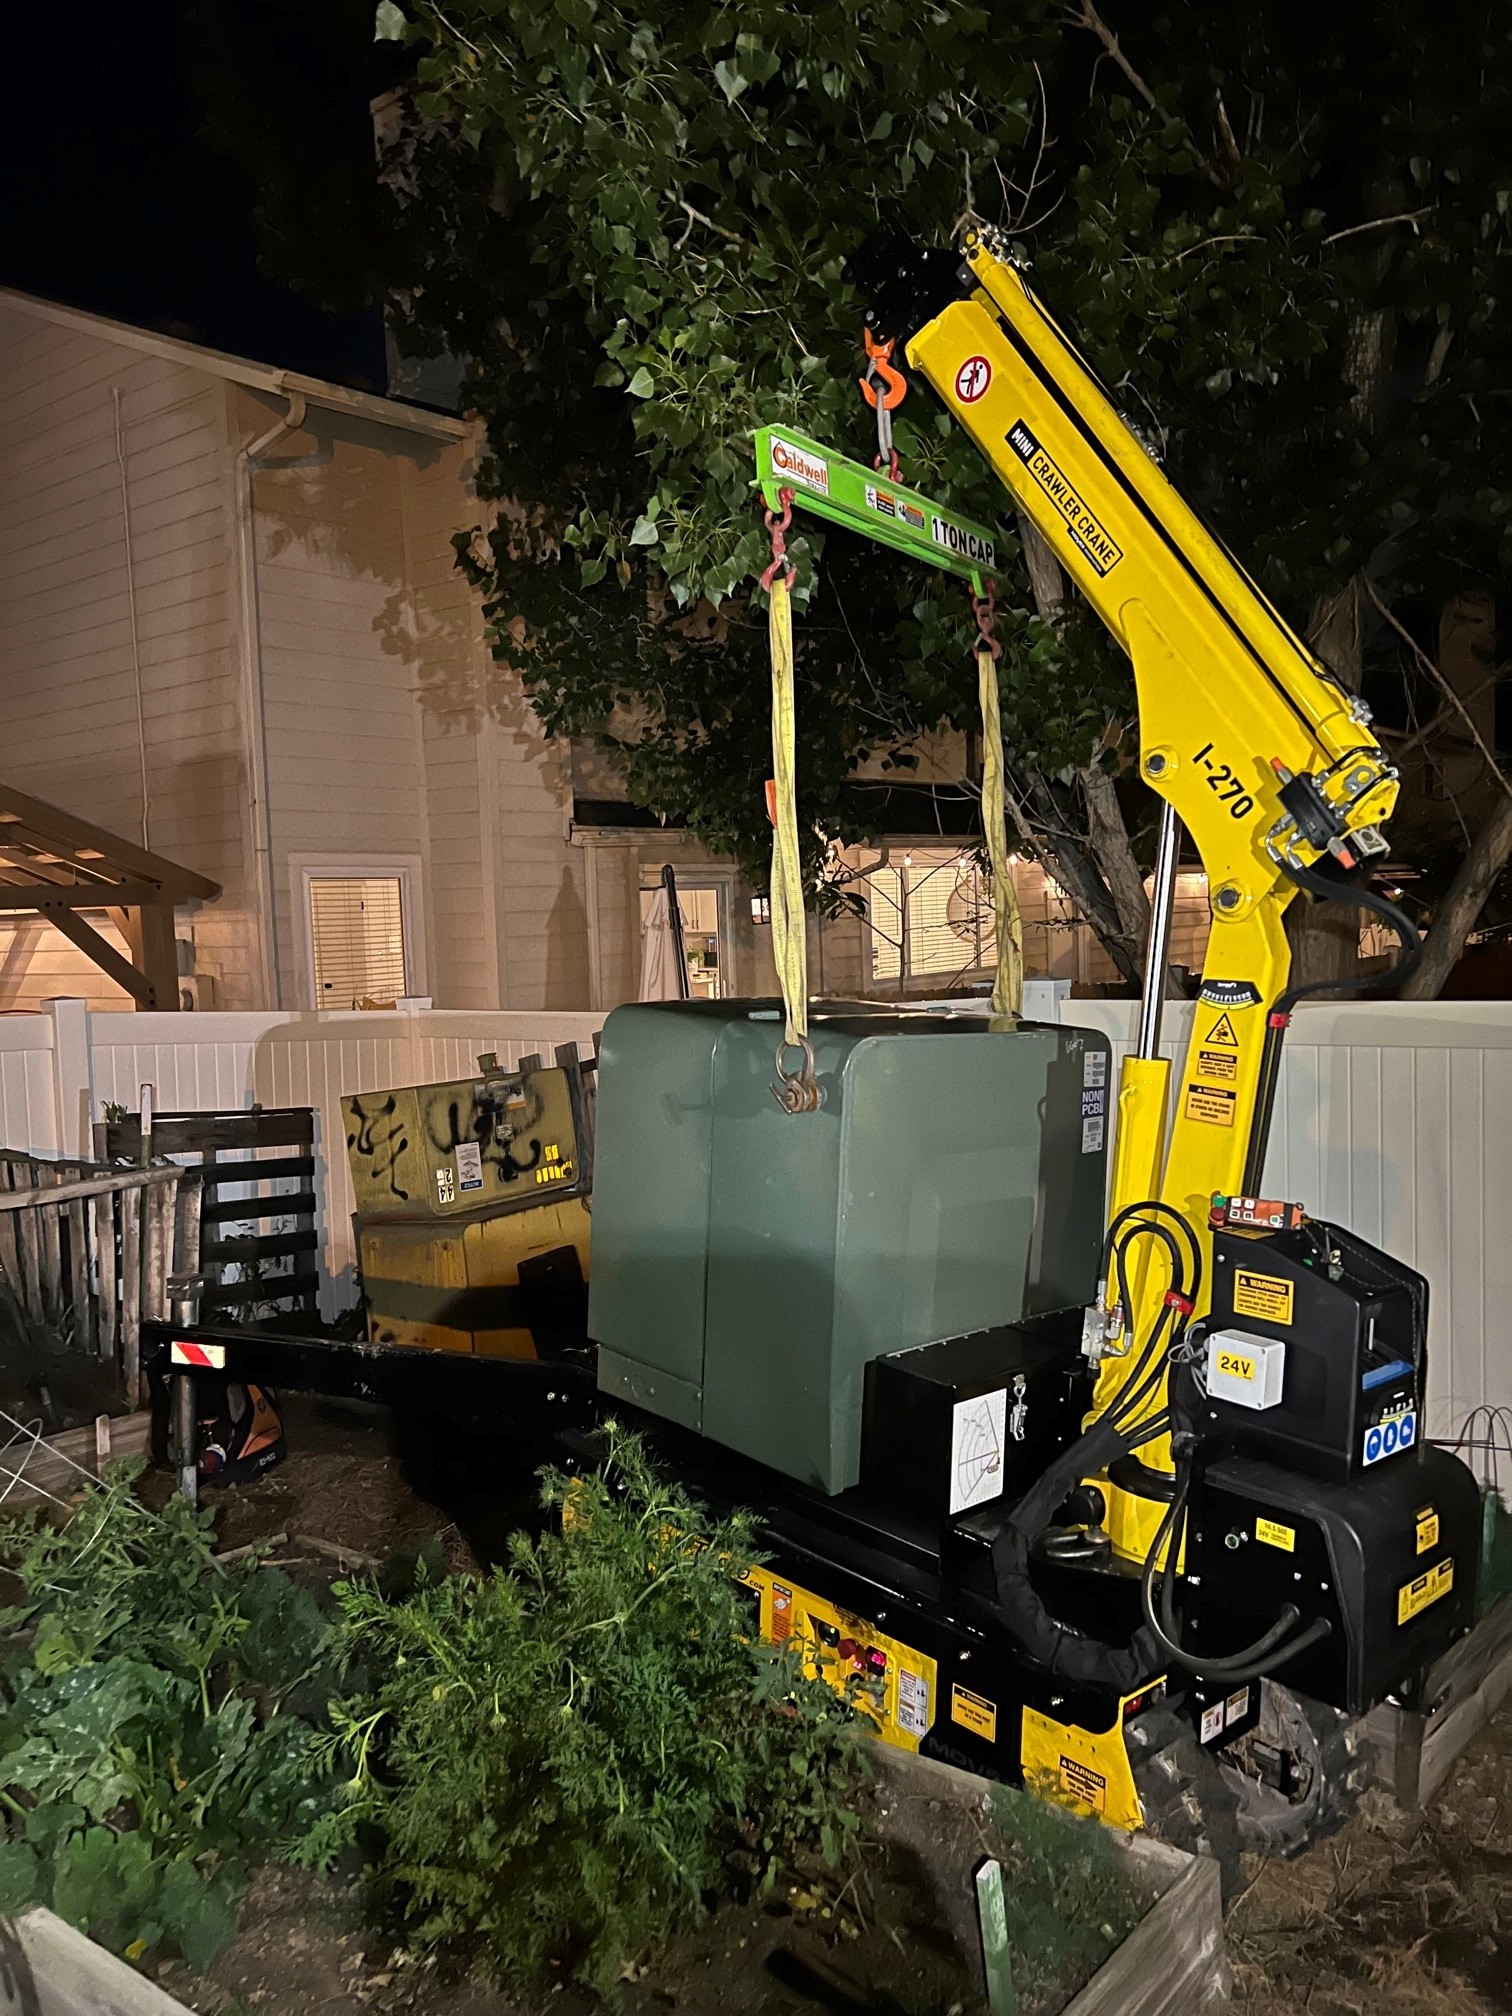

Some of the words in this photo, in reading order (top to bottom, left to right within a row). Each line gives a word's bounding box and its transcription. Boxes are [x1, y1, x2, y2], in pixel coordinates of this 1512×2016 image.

[773, 441, 827, 486] Caldwell
[1011, 428, 1034, 457] MINI
[1033, 456, 1081, 520] CRAWLER
[1077, 516, 1115, 565] CRANE
[932, 517, 939, 541] 1
[940, 521, 967, 555] TON
[968, 535, 993, 564] CAP
[1192, 742, 1254, 819] I-270
[1081, 1103, 1099, 1115] PCB
[1082, 1090, 1099, 1103] NON
[1250, 1278, 1286, 1293] WARNING
[1221, 1356, 1250, 1375] 24V
[1068, 1761, 1104, 1787] WARNING
